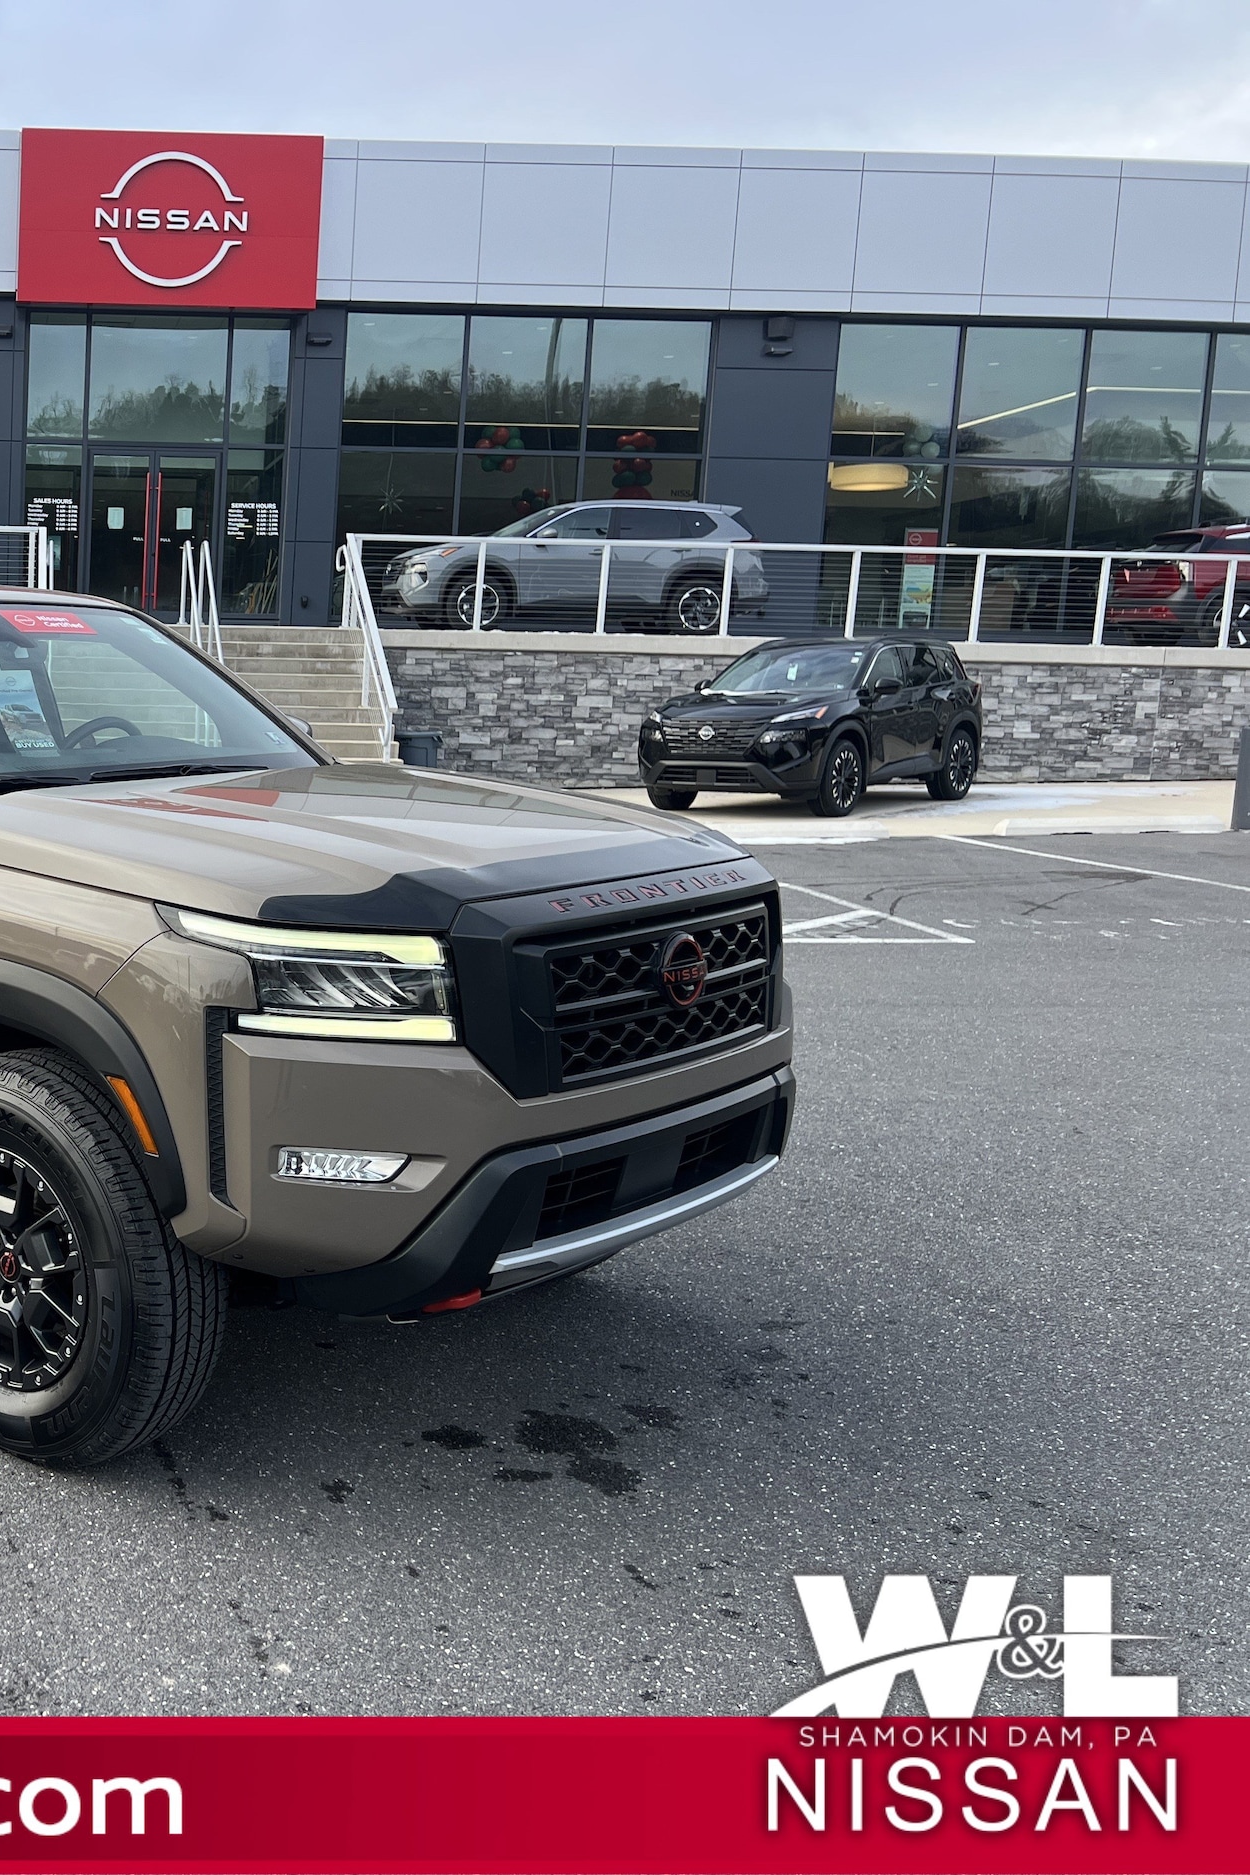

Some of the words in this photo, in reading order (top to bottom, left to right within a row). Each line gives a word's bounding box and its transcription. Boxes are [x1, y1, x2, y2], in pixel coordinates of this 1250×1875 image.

[95, 207, 248, 232] NISSAN
[670, 489, 694, 498] NISS
[35, 615, 69, 623] Nissan
[43, 621, 84, 630] Certified
[548, 868, 747, 913] FRONTIER
[663, 965, 706, 983] NISSA
